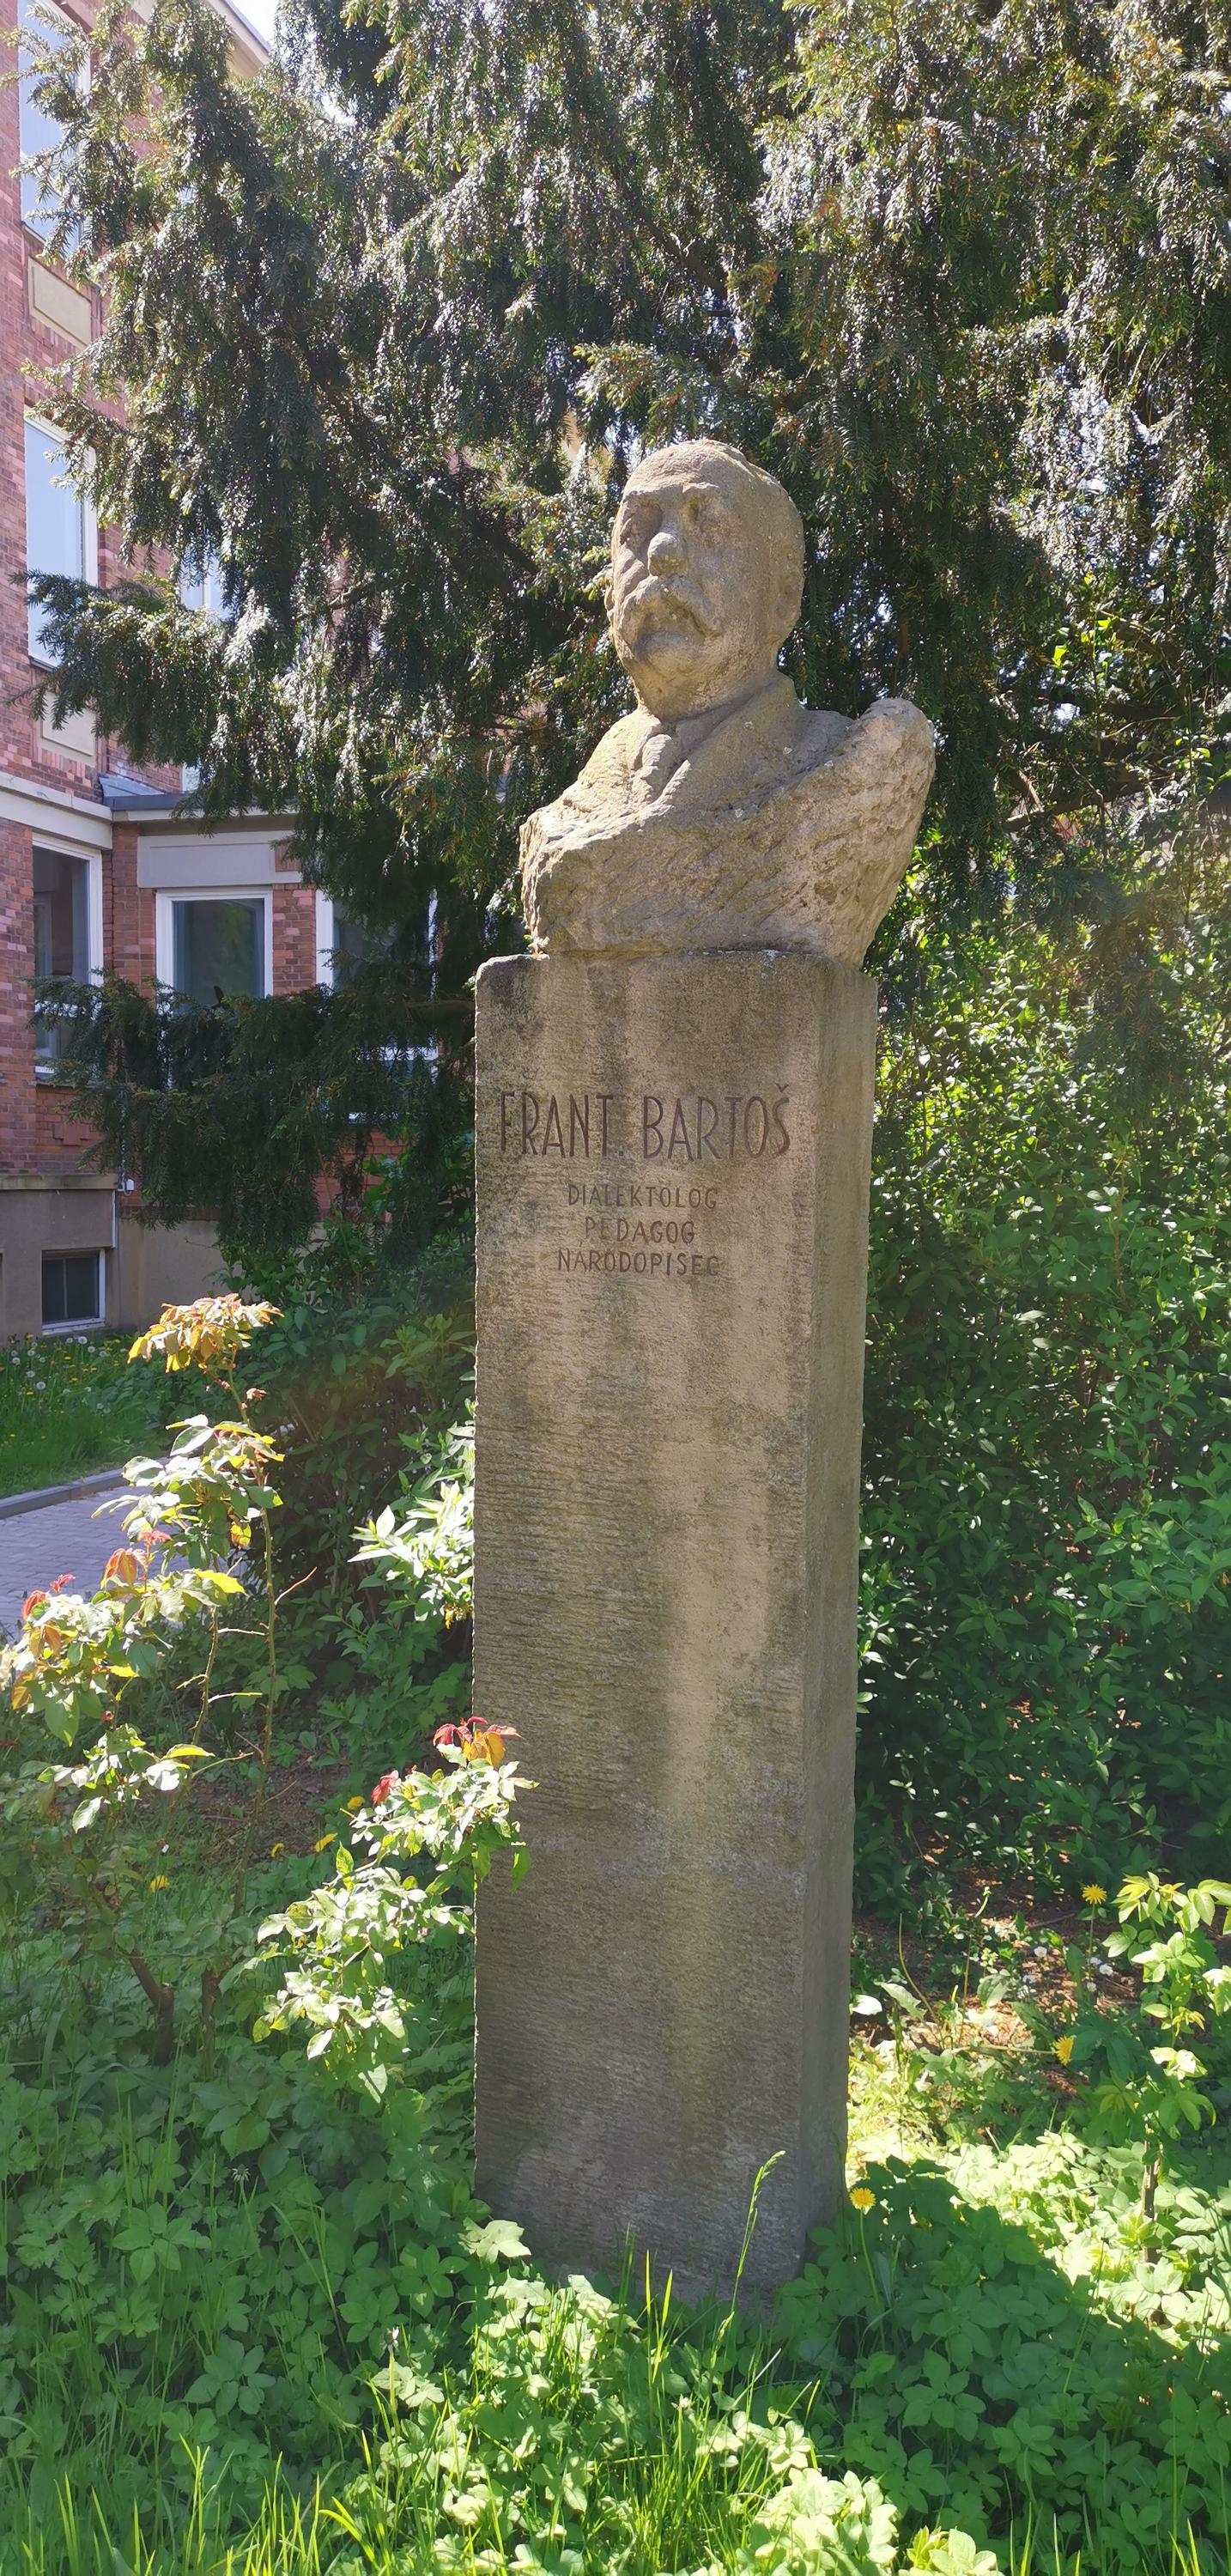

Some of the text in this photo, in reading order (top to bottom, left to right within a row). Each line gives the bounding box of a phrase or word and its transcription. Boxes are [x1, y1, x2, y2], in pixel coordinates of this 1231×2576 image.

[500, 1083, 791, 1161] FRANT. BARTOŠ
[567, 1183, 719, 1209] DIALEKTOLOG
[585, 1216, 695, 1243] PEDAGOG
